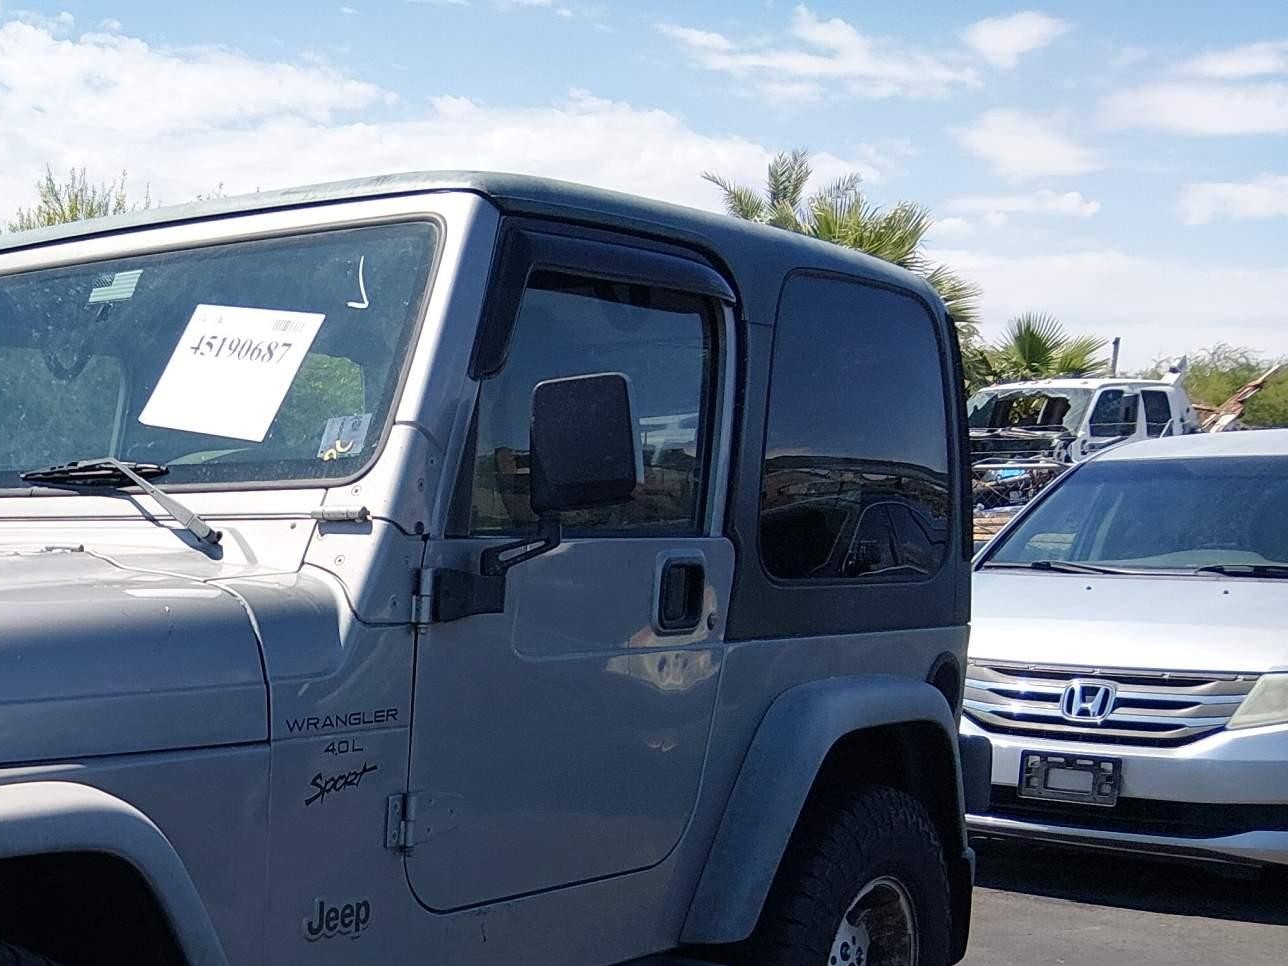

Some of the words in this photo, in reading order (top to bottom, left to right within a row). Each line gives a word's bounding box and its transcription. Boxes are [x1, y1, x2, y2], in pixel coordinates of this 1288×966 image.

[189, 334, 293, 363] 45190687
[286, 708, 398, 733] WRANGLER
[306, 899, 371, 938] Jeep
